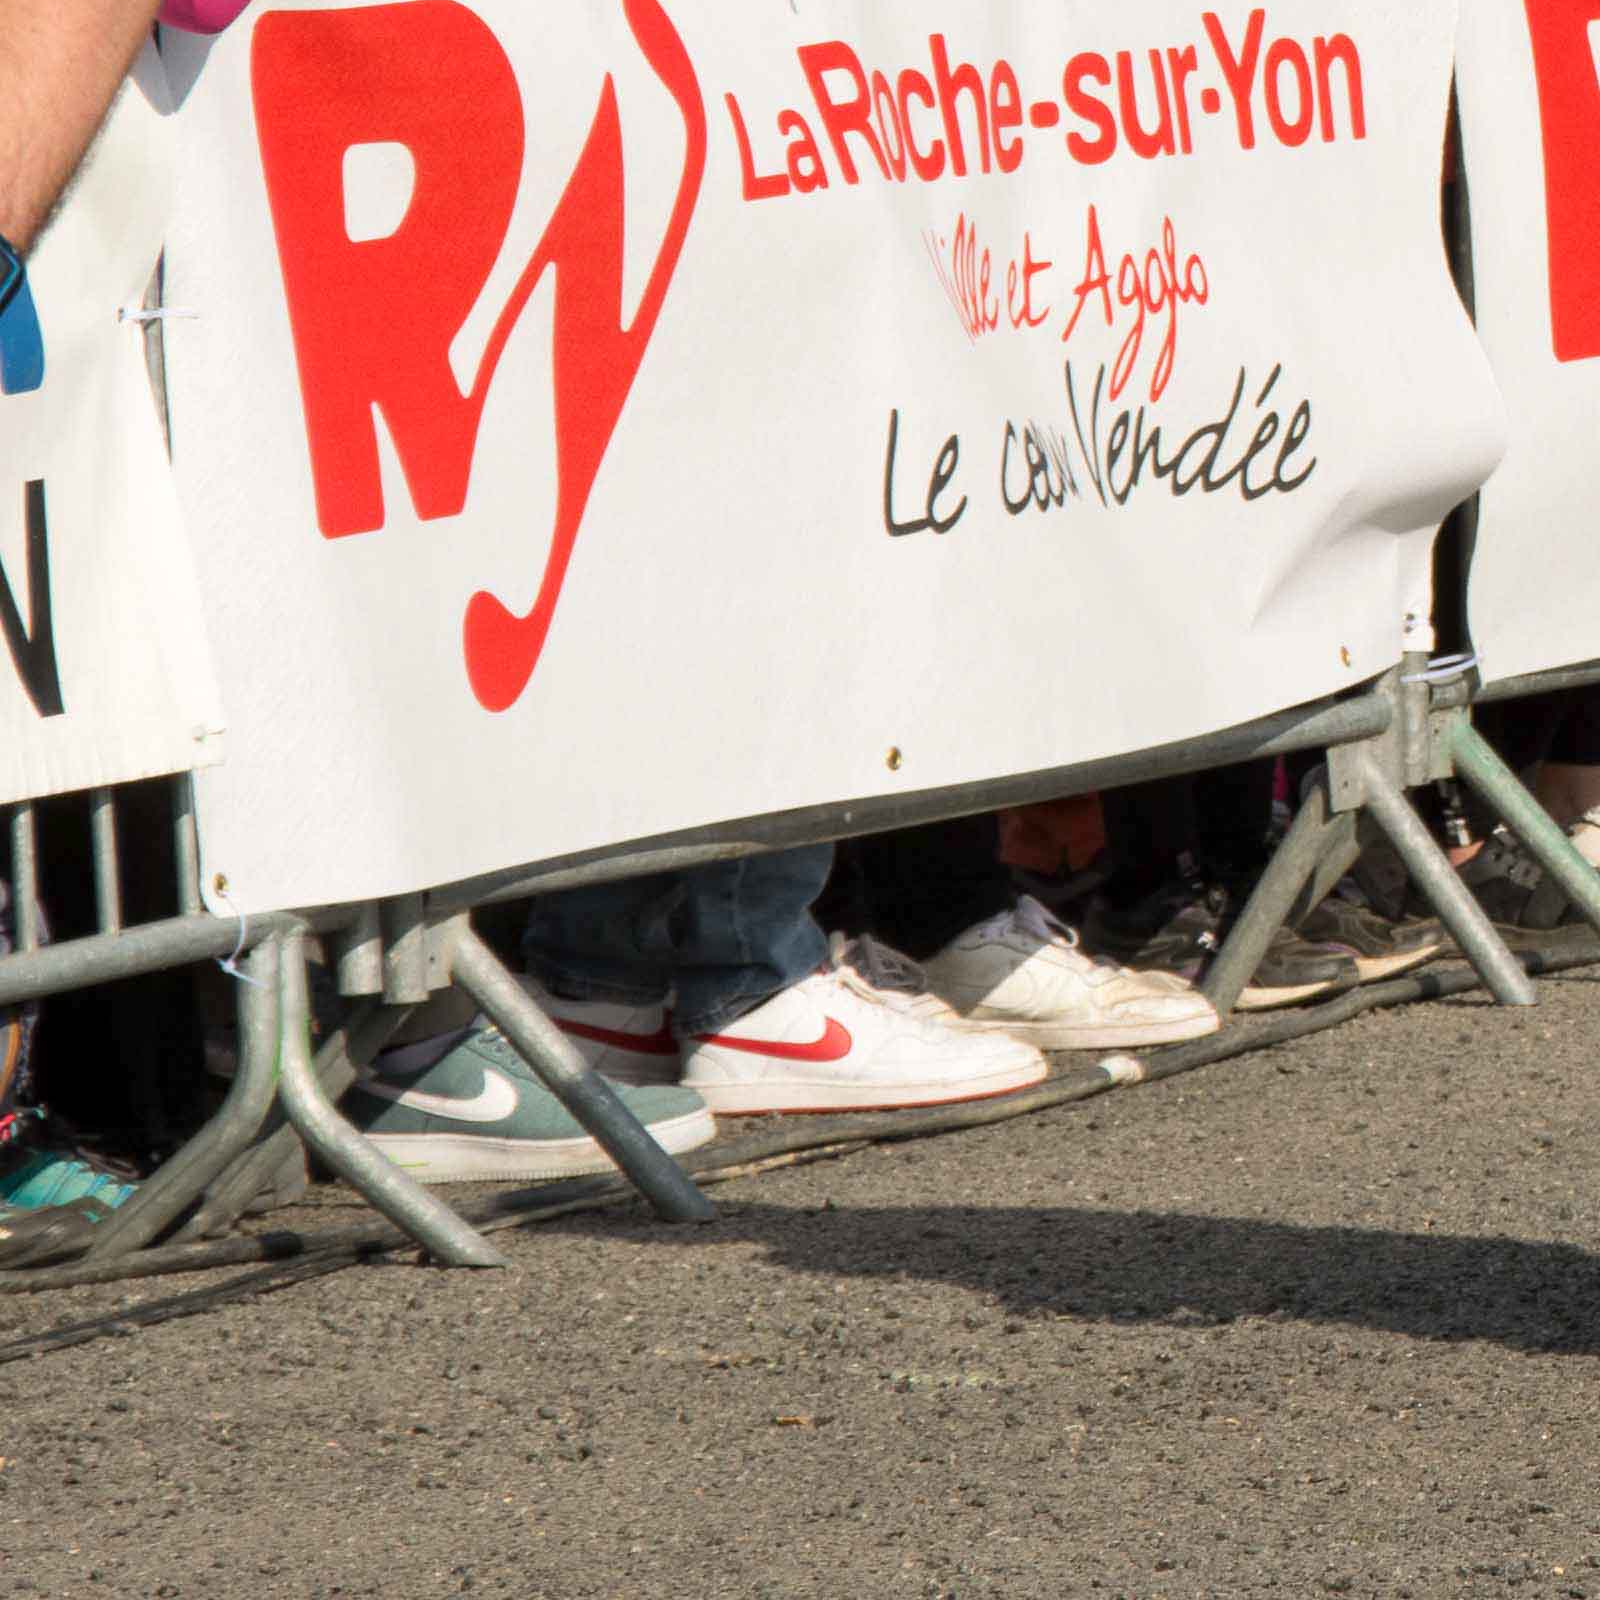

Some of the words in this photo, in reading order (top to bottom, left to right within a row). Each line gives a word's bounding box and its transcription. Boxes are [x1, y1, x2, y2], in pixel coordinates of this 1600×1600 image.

[1007, 231, 1053, 329] et
[1062, 203, 1209, 403] Agglo
[884, 408, 968, 538] Le
[1066, 359, 1318, 508] Vendée
